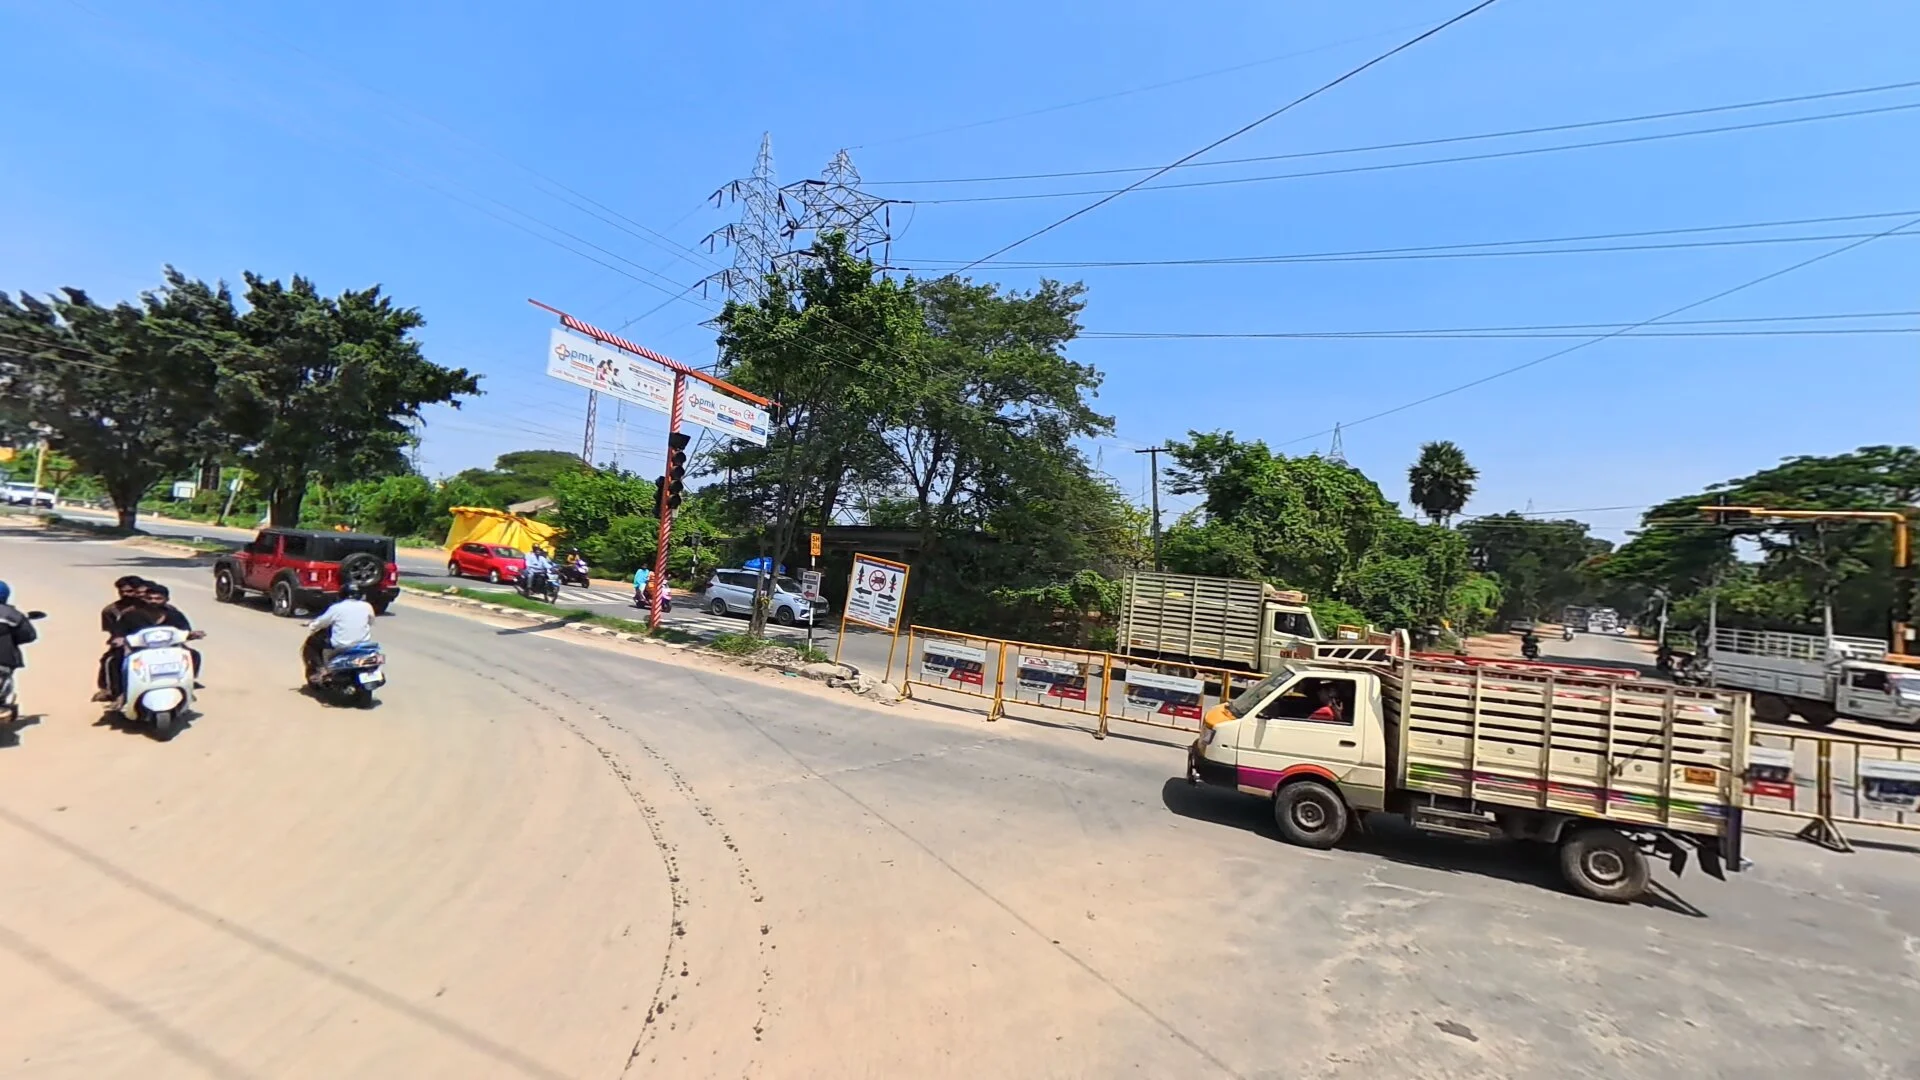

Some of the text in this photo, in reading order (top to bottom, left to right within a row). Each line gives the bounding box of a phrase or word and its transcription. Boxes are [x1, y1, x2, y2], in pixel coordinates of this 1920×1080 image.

[571, 350, 595, 366] pmk
[699, 399, 716, 409] pmk
[719, 404, 727, 412] CT
